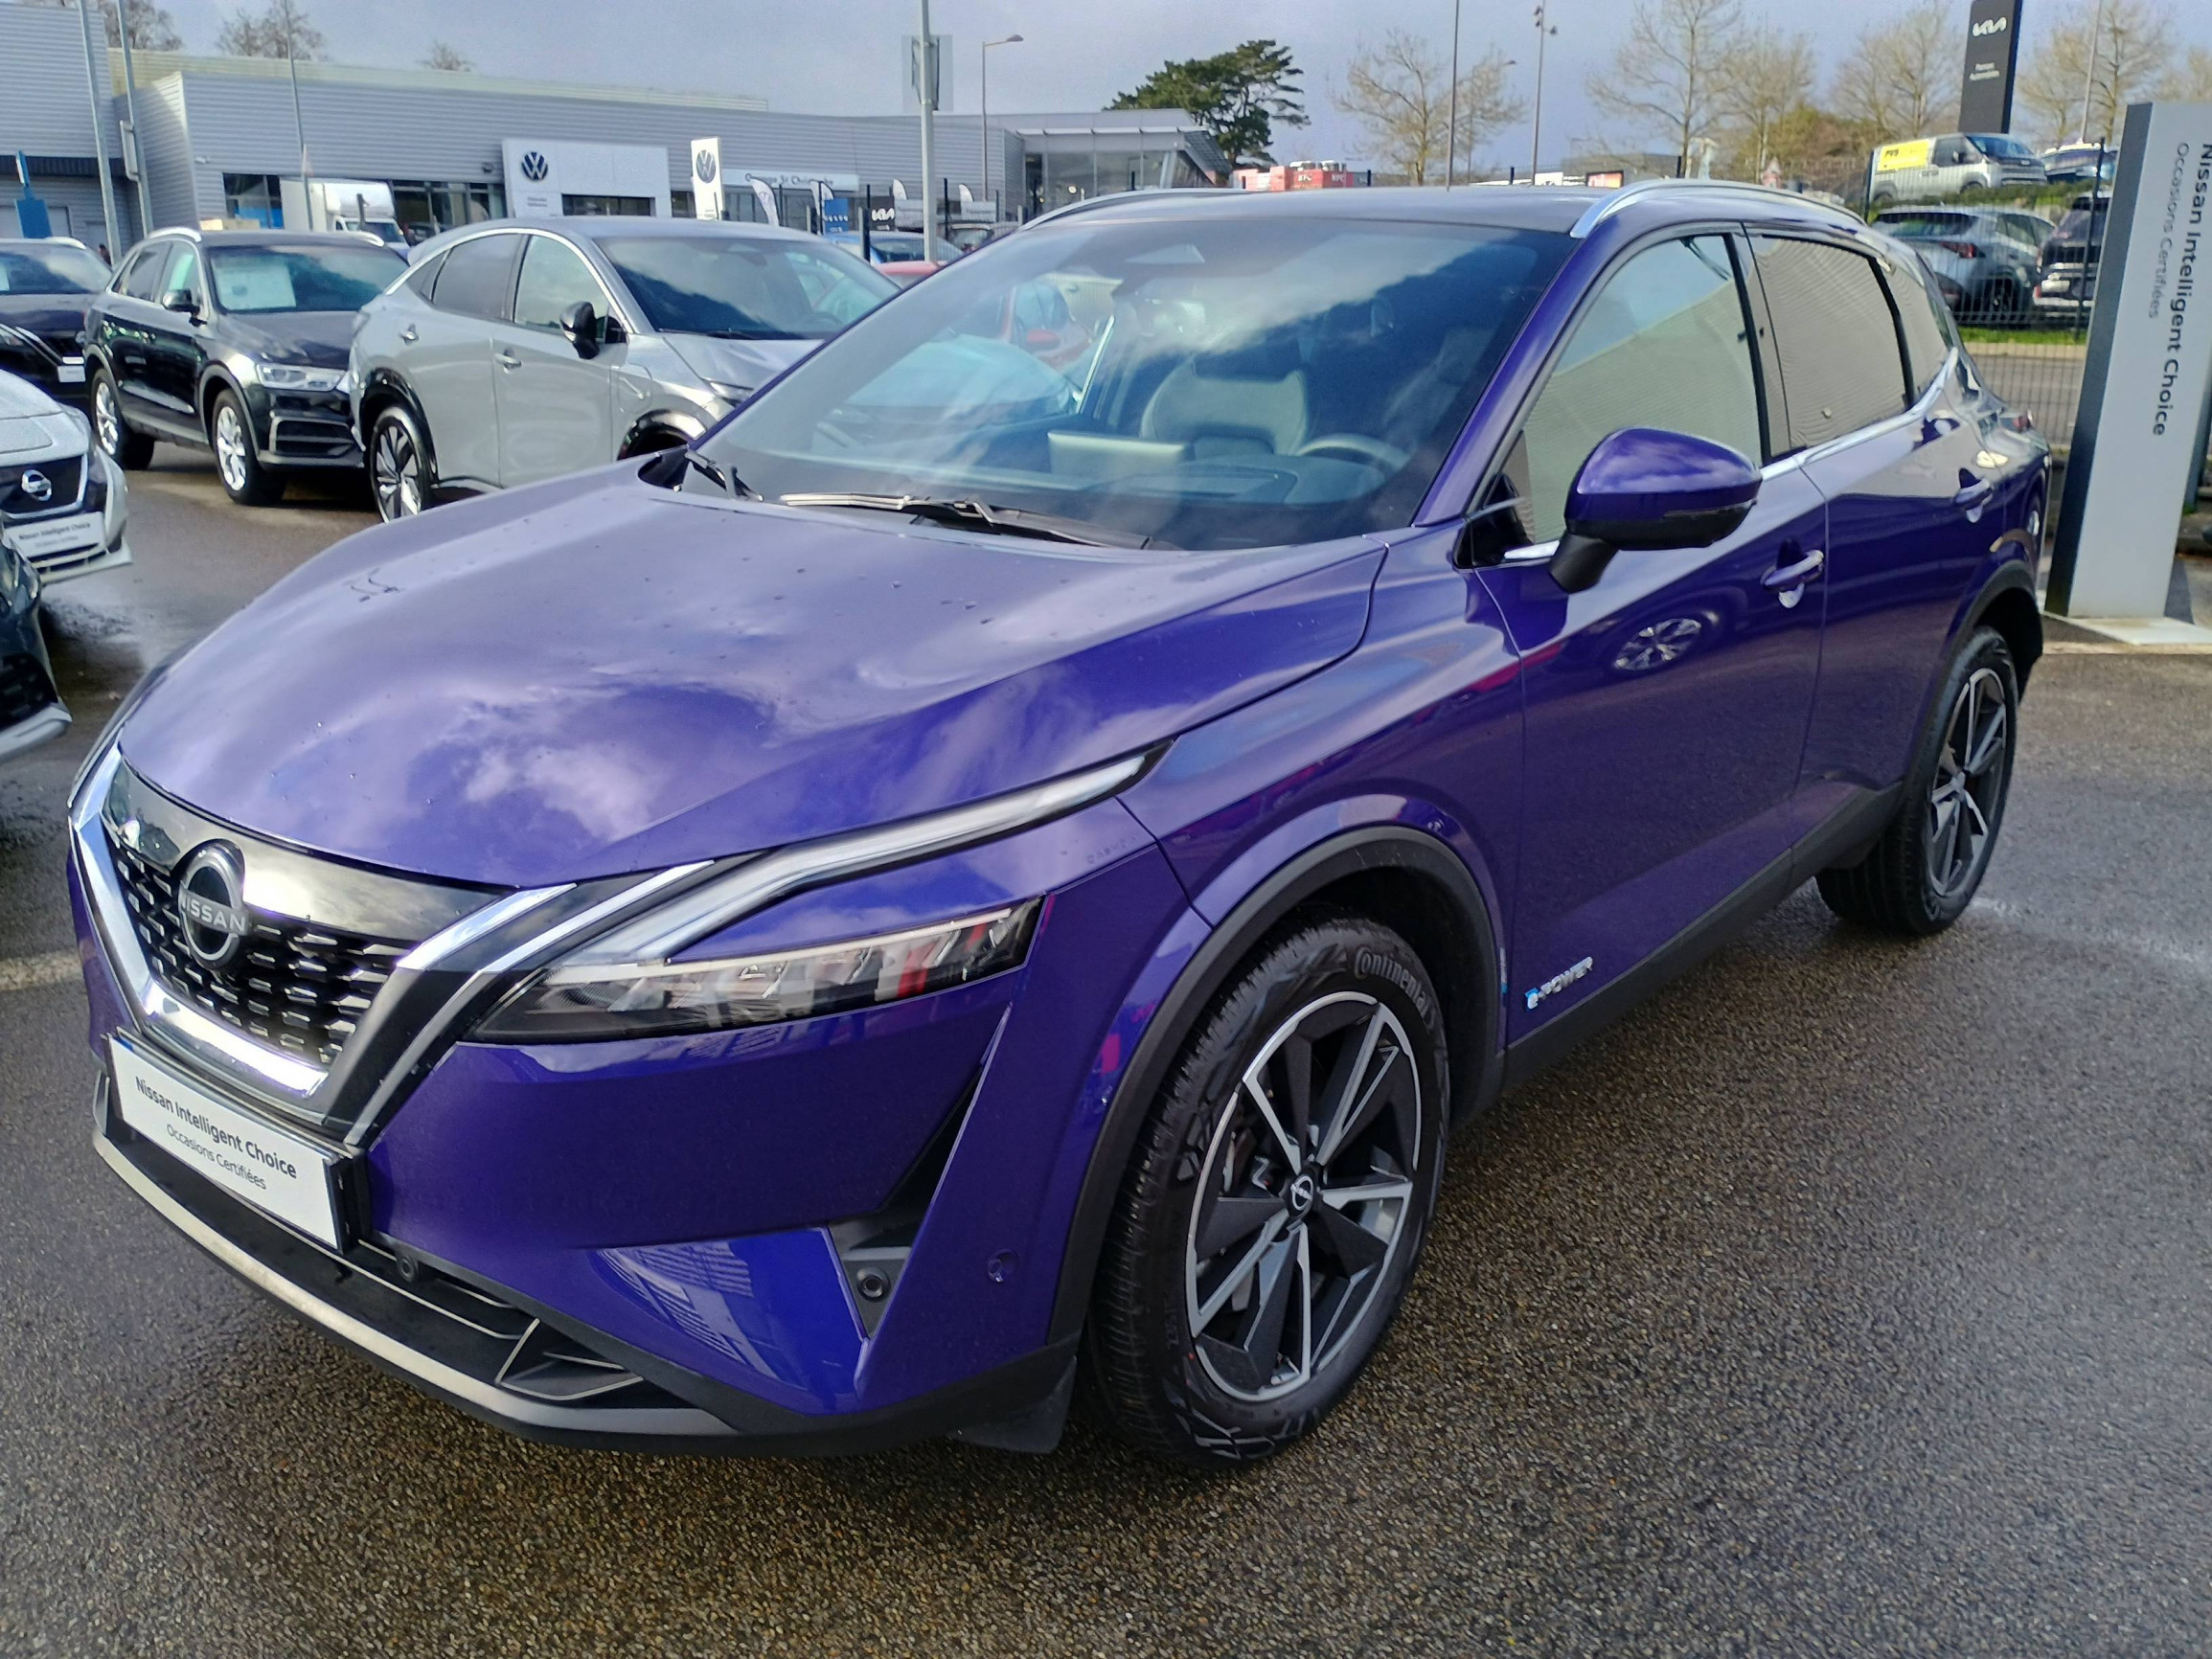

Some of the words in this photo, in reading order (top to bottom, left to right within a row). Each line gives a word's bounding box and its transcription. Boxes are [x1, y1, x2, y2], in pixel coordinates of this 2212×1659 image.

[2162, 142, 2189, 234] Occasions
[2188, 143, 2212, 224] Nissan
[2167, 232, 2201, 352] Intelligent
[2153, 358, 2178, 436] Choice
[178, 888, 246, 933] NISSAN
[1354, 946, 1432, 1018] Continental
[135, 1076, 173, 1112] Nissan
[175, 1102, 242, 1153] Intelligent
[245, 1141, 297, 1179] Choice
[167, 1124, 215, 1162] Occasions
[217, 1153, 267, 1191] Certifiées
